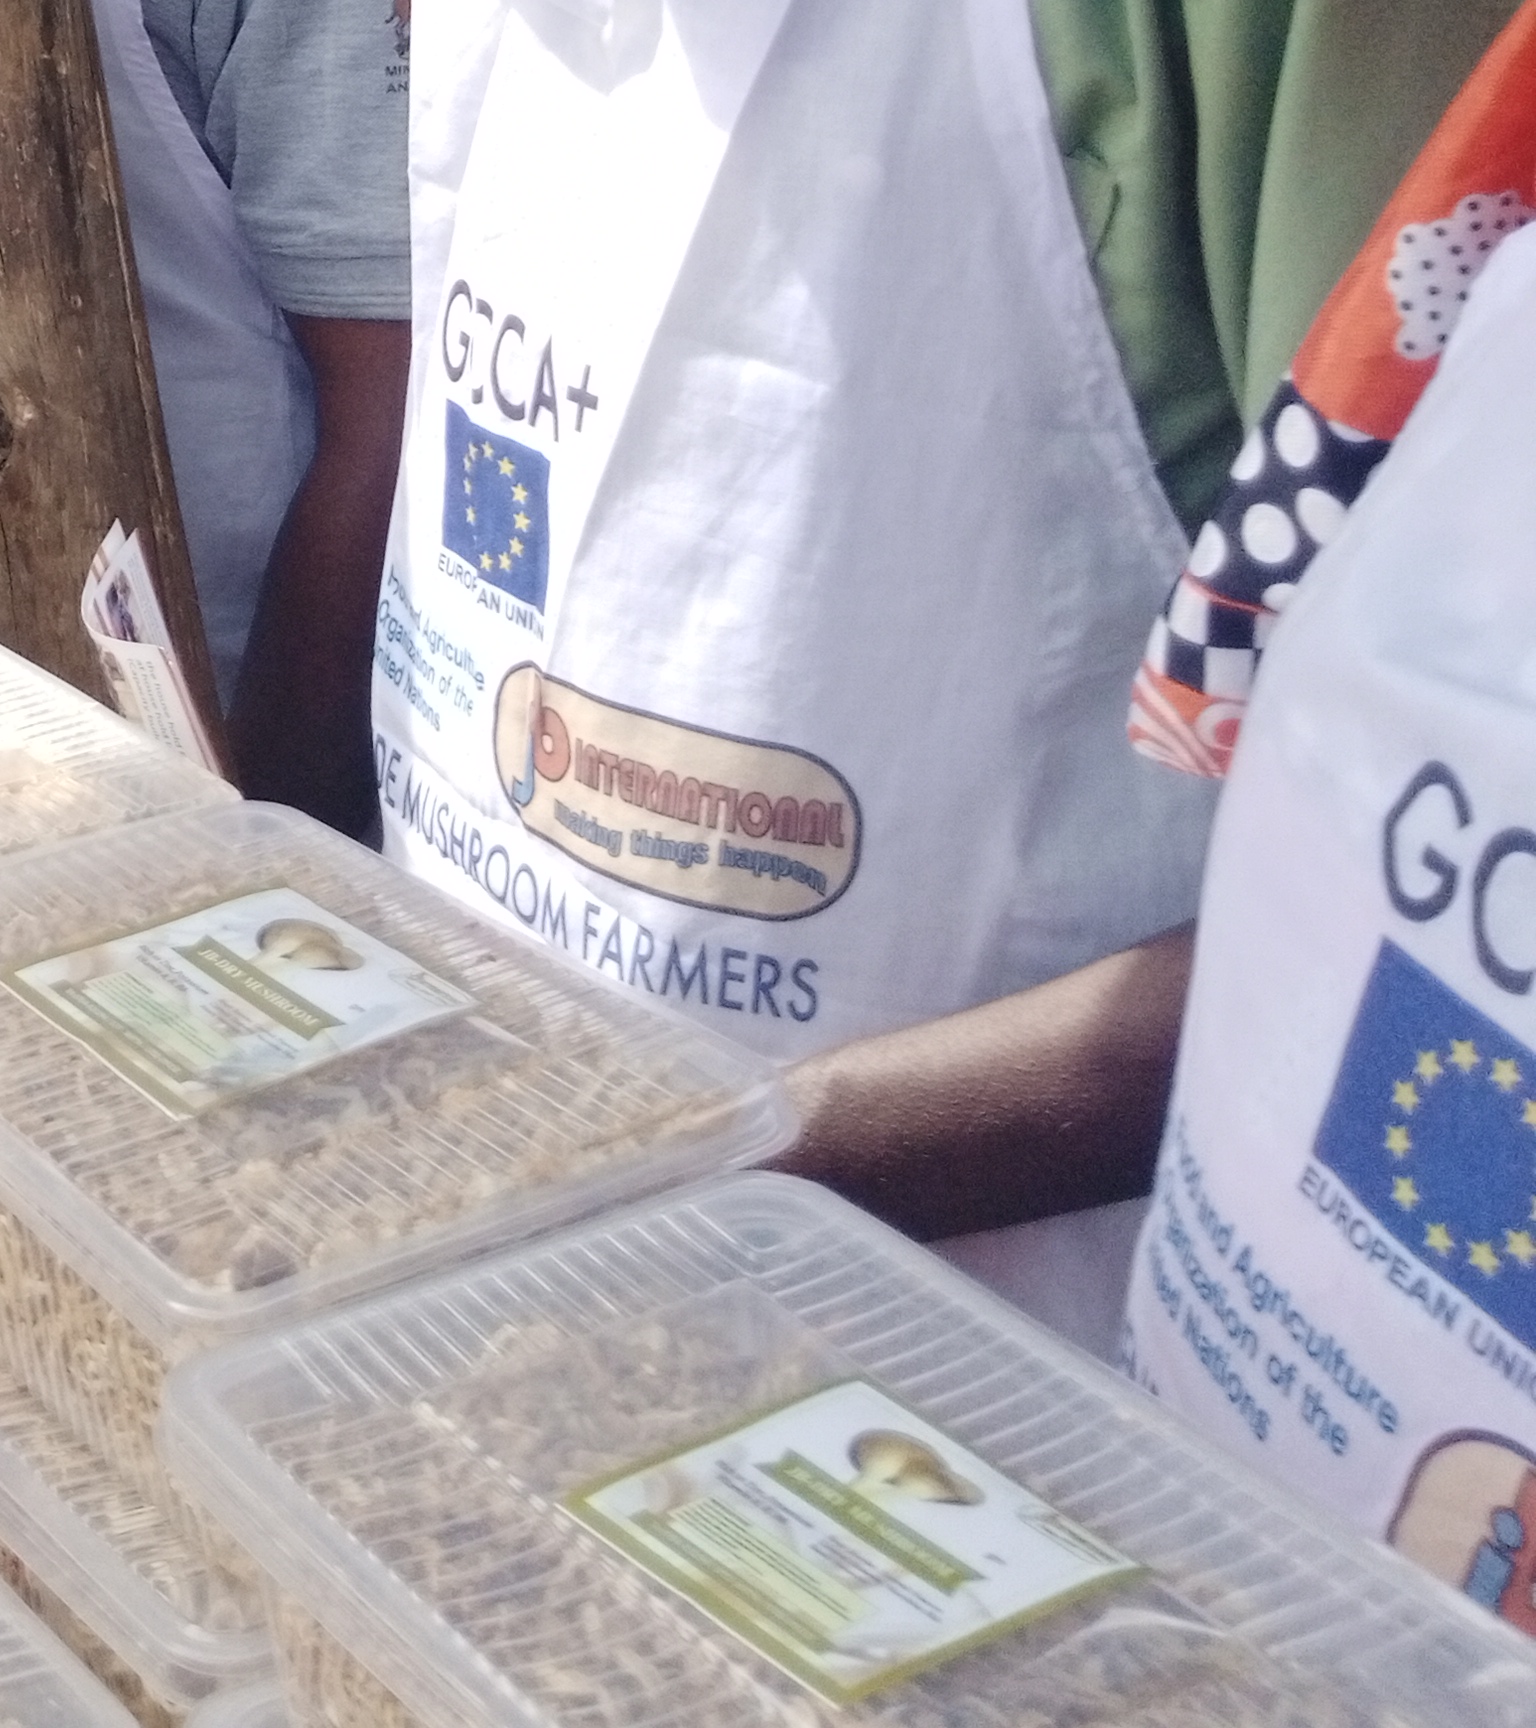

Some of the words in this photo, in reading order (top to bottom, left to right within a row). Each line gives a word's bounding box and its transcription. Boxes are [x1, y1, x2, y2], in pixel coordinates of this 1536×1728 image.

[439, 675, 453, 697] of
[453, 680, 474, 717] the
[403, 764, 569, 952] MUSHROOM
[581, 900, 821, 1025] FARMERS
[630, 828, 709, 868] things
[717, 838, 827, 898] happen
[242, 975, 321, 1026] MUSHROOM
[1296, 1164, 1463, 1333] EUROPEAN
[1233, 1244, 1400, 1436] Agriculture
[1301, 1383, 1349, 1457] the
